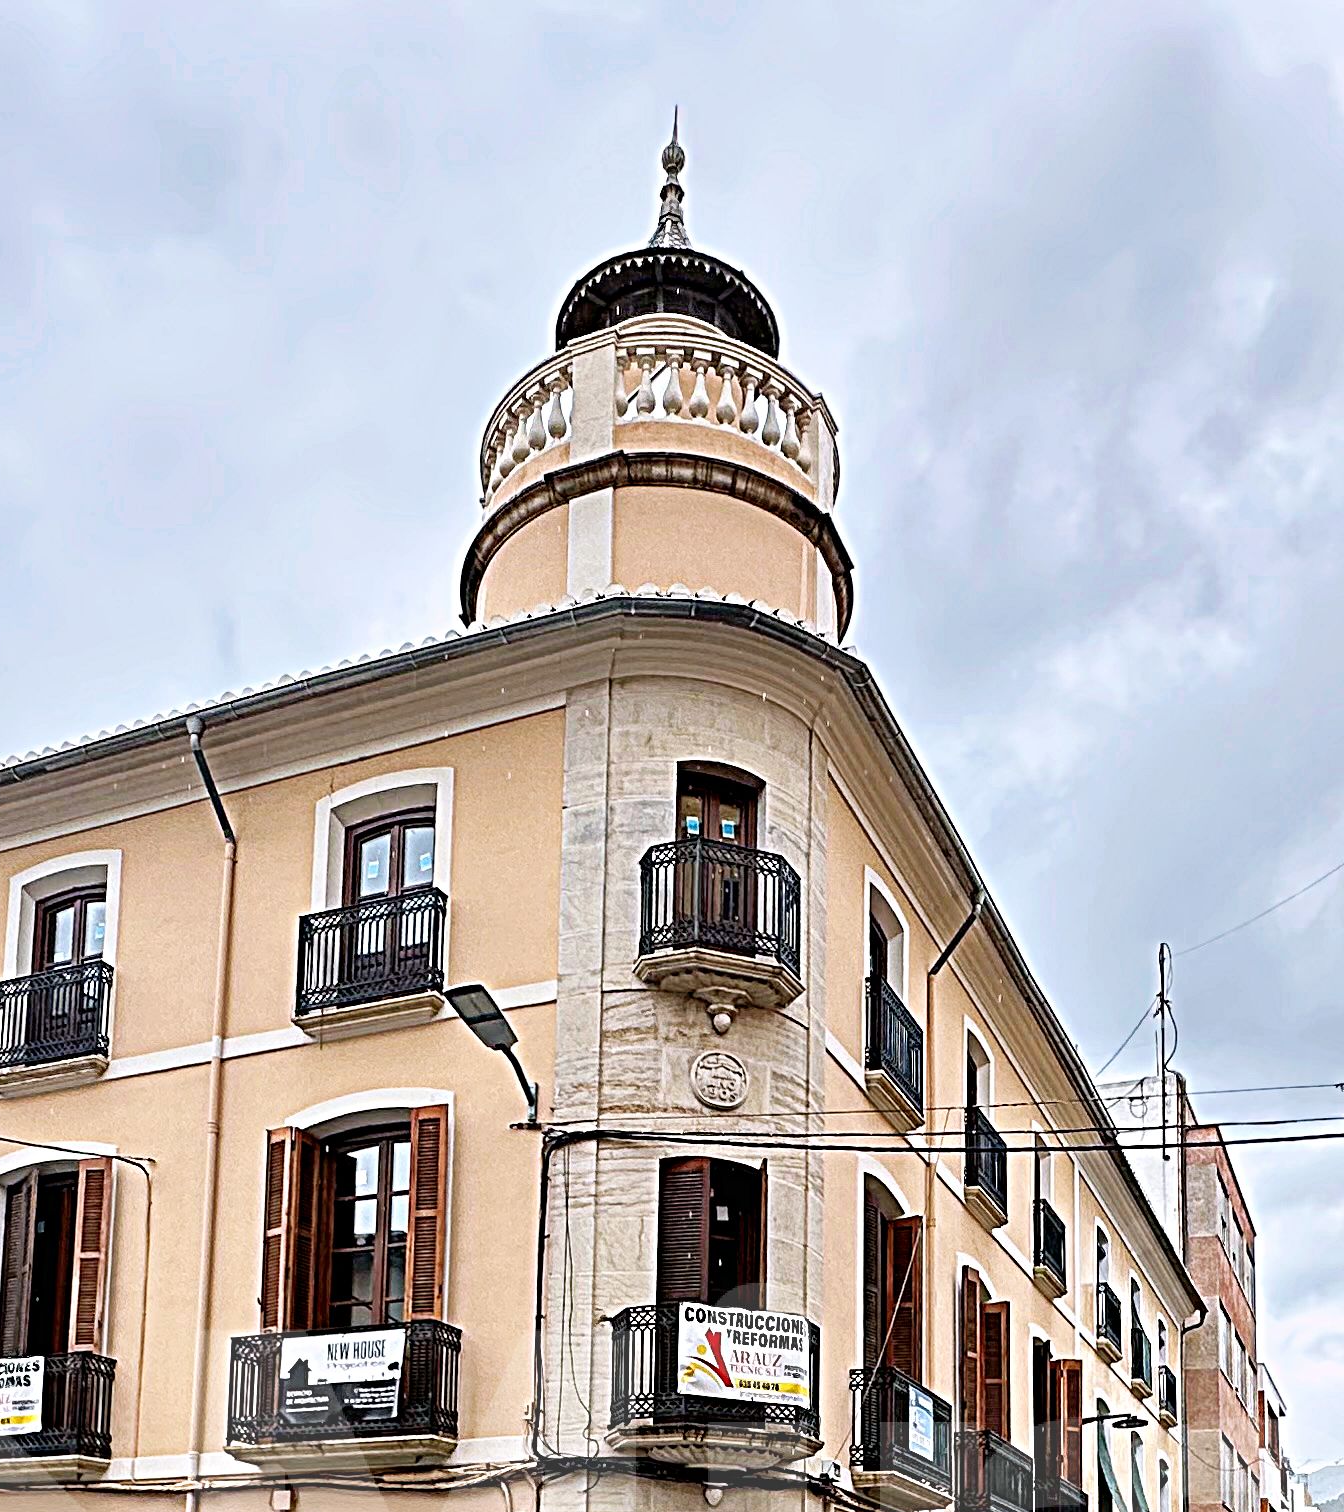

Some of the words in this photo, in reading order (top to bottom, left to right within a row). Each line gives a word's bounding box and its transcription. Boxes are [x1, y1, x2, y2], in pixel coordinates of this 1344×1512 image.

[327, 1342, 350, 1361] NEW
[353, 1339, 386, 1359] HOUSE
[732, 1330, 803, 1352] REFORMAS
[729, 1349, 783, 1367] ARAUZ
